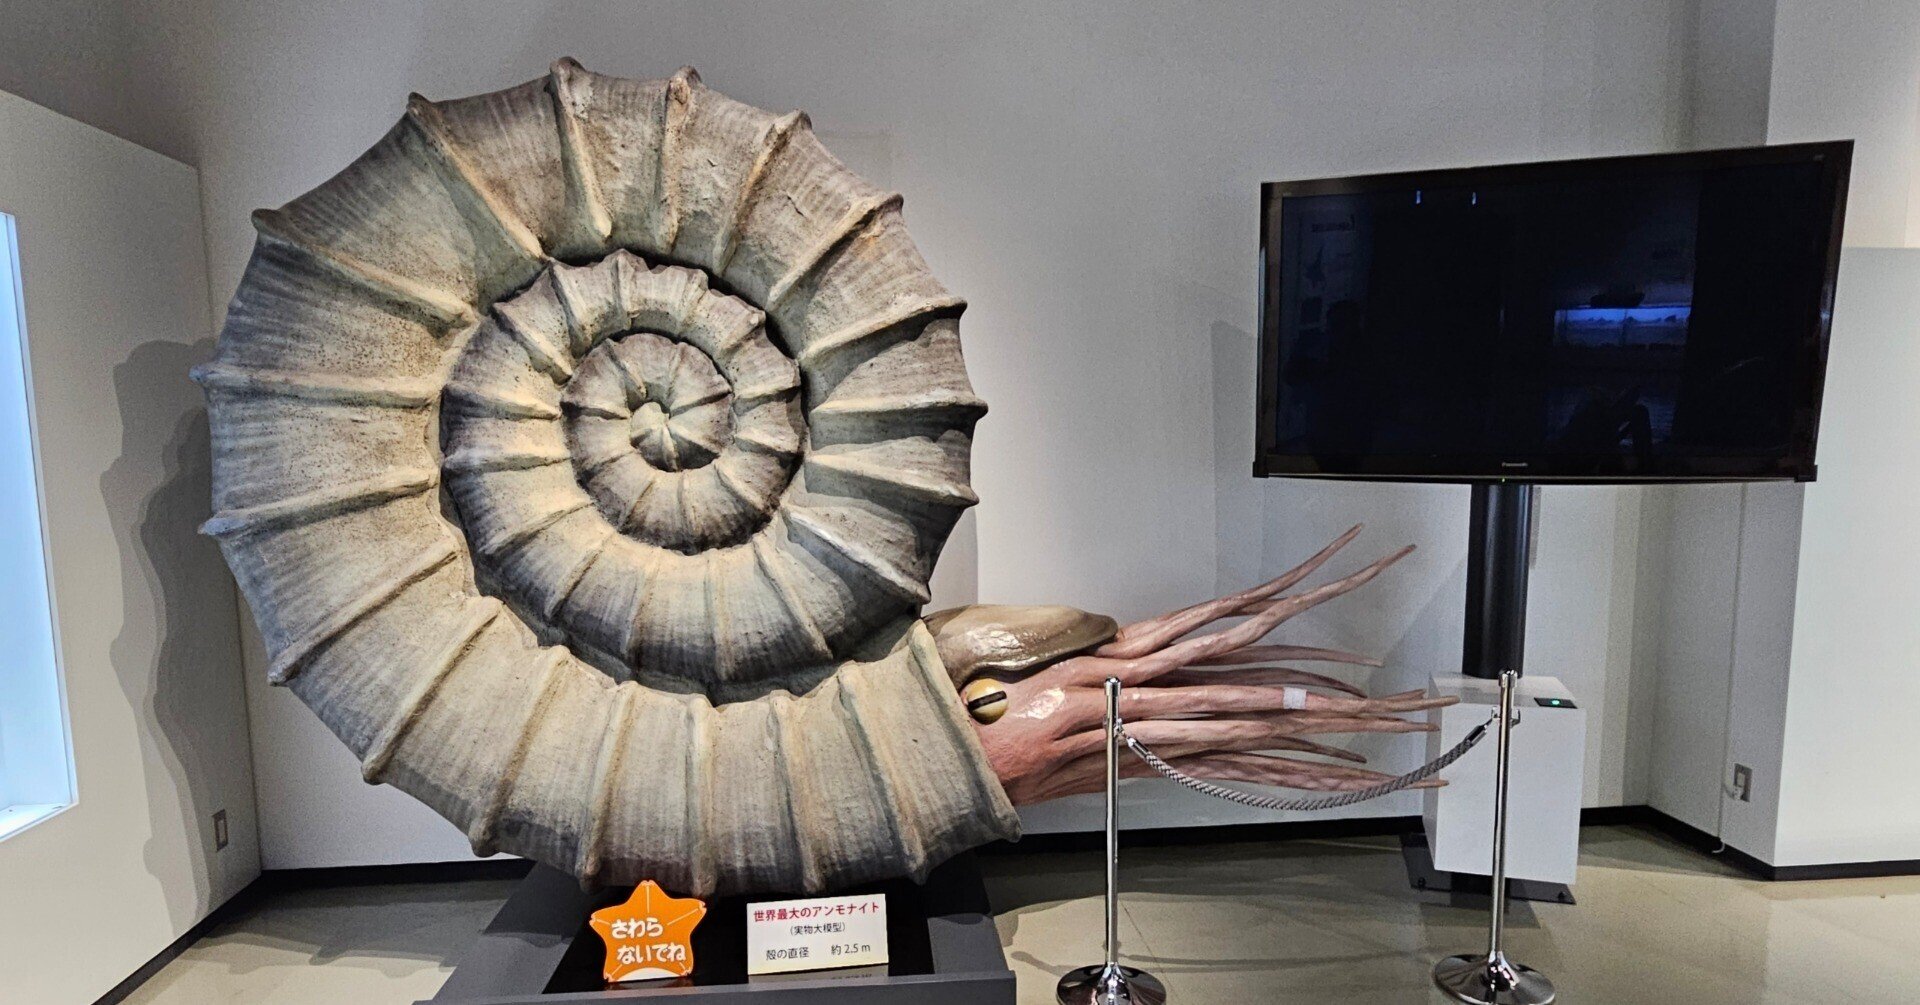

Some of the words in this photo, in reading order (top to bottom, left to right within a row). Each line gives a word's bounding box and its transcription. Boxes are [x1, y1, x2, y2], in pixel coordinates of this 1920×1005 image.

[753, 902, 880, 922] 世界最大のアンモナイト
[611, 917, 664, 938] さわら
[790, 922, 846, 936] (実物大模型)
[617, 942, 687, 965] ないでね
[766, 947, 810, 961] 殻の直径
